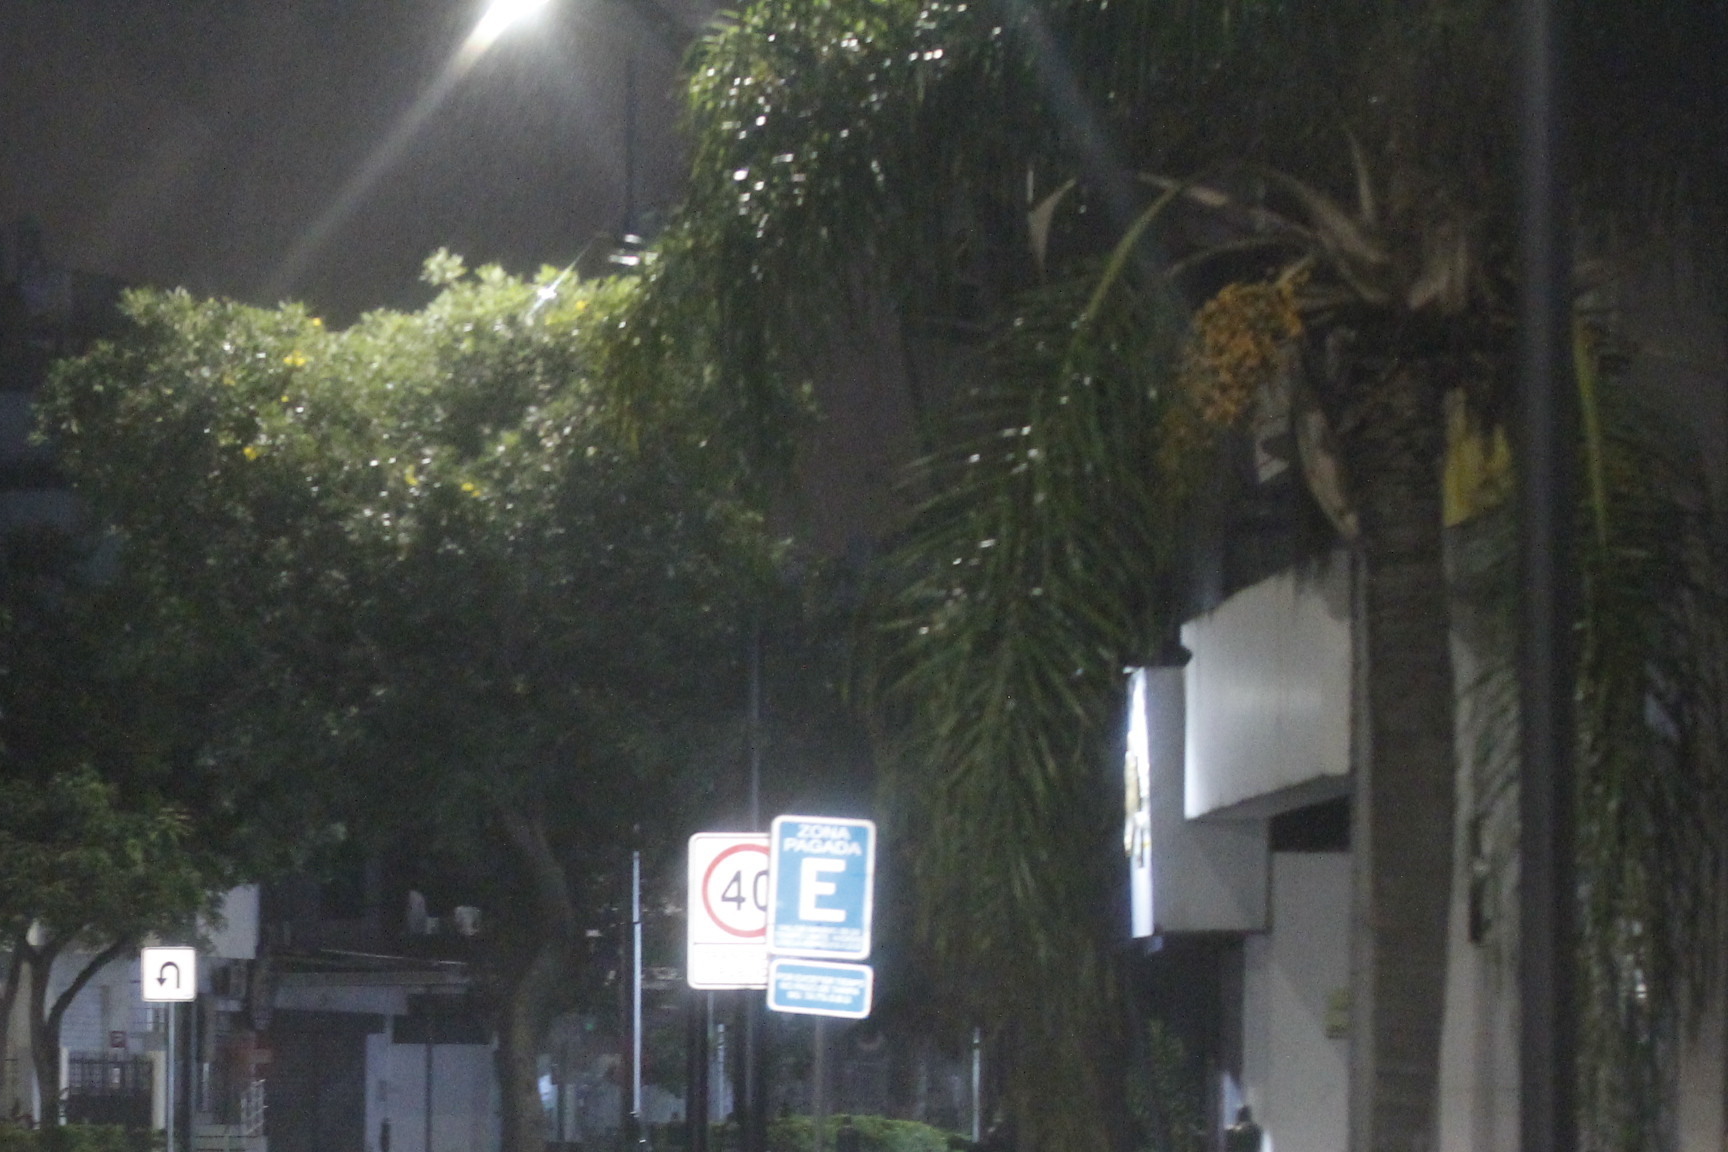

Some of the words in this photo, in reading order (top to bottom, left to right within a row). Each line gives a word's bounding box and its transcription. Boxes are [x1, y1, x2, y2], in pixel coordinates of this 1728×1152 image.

[783, 837, 862, 855] PAGADA
[797, 824, 850, 840] ZONA
[721, 869, 768, 913] 40
[798, 856, 846, 923] E
